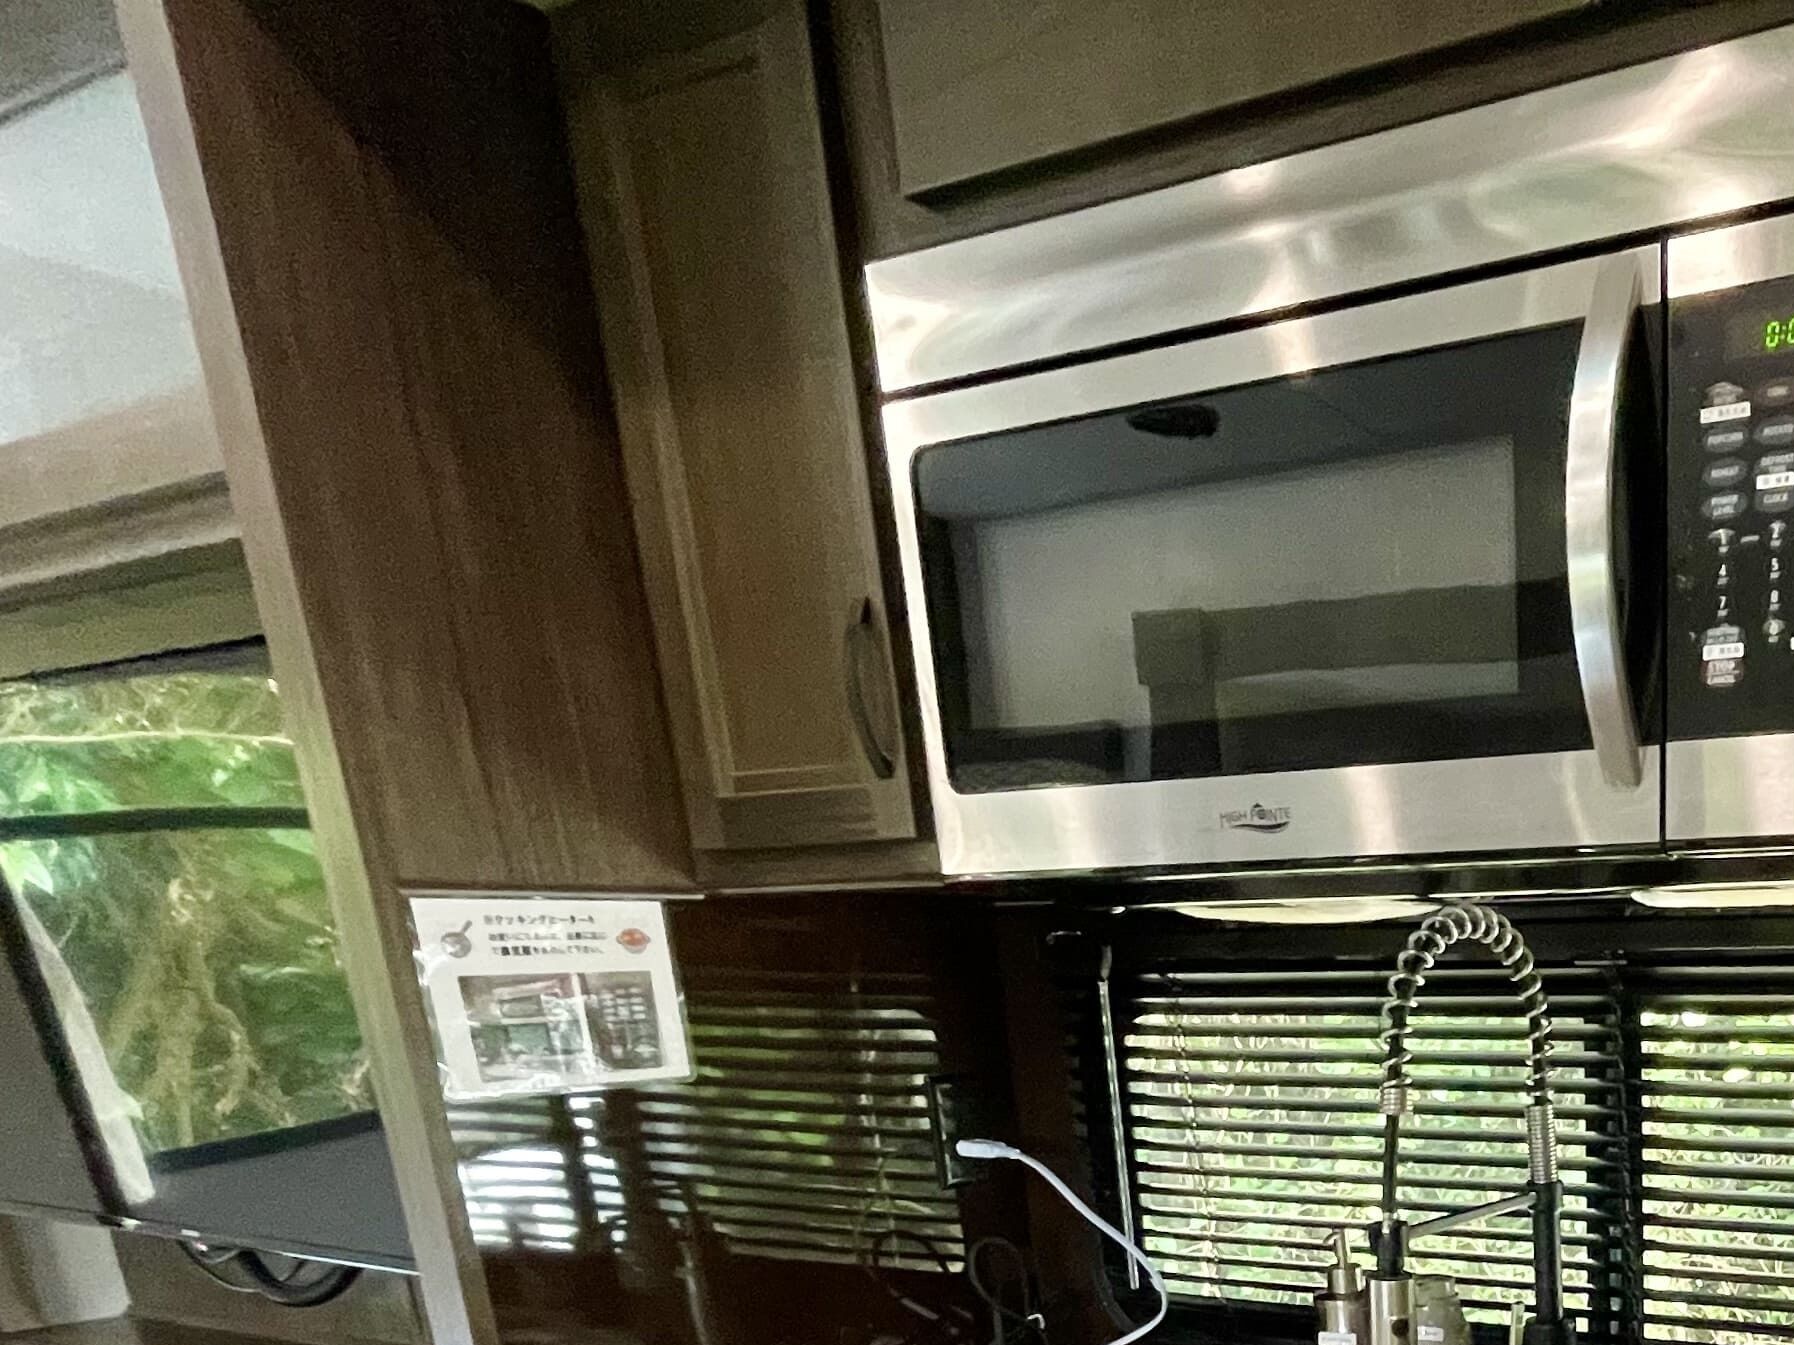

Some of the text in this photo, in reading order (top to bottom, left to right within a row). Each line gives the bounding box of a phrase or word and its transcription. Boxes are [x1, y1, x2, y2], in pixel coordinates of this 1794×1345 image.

[1718, 564, 1727, 576] 4
[1771, 557, 1779, 571] 5
[1719, 595, 1727, 609] 7
